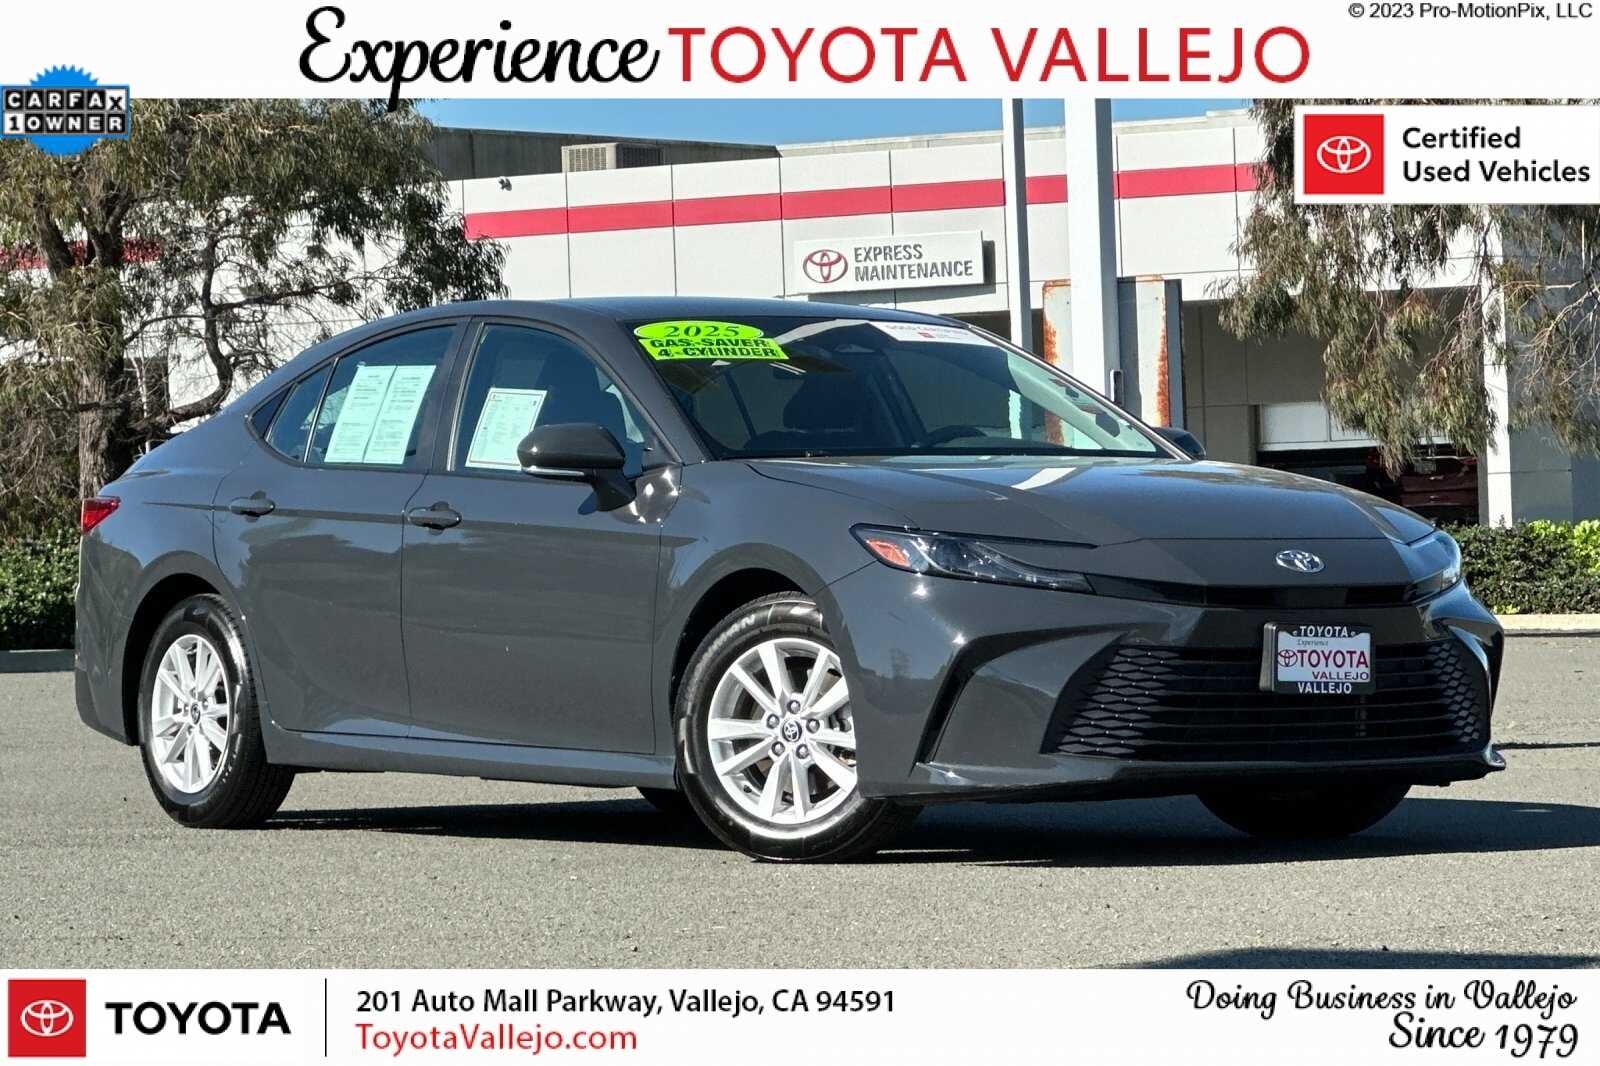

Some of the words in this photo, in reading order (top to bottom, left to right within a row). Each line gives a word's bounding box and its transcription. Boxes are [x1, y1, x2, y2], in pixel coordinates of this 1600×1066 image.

[854, 244, 923, 262] EXPRESS
[854, 260, 973, 282] MAINTENANCE
[664, 325, 740, 337] 2025
[1299, 625, 1348, 637] TOYOTA
[1296, 649, 1369, 668] TOYOTA
[1312, 671, 1369, 680] VALLEJO
[1297, 682, 1352, 694] VALLEJO
